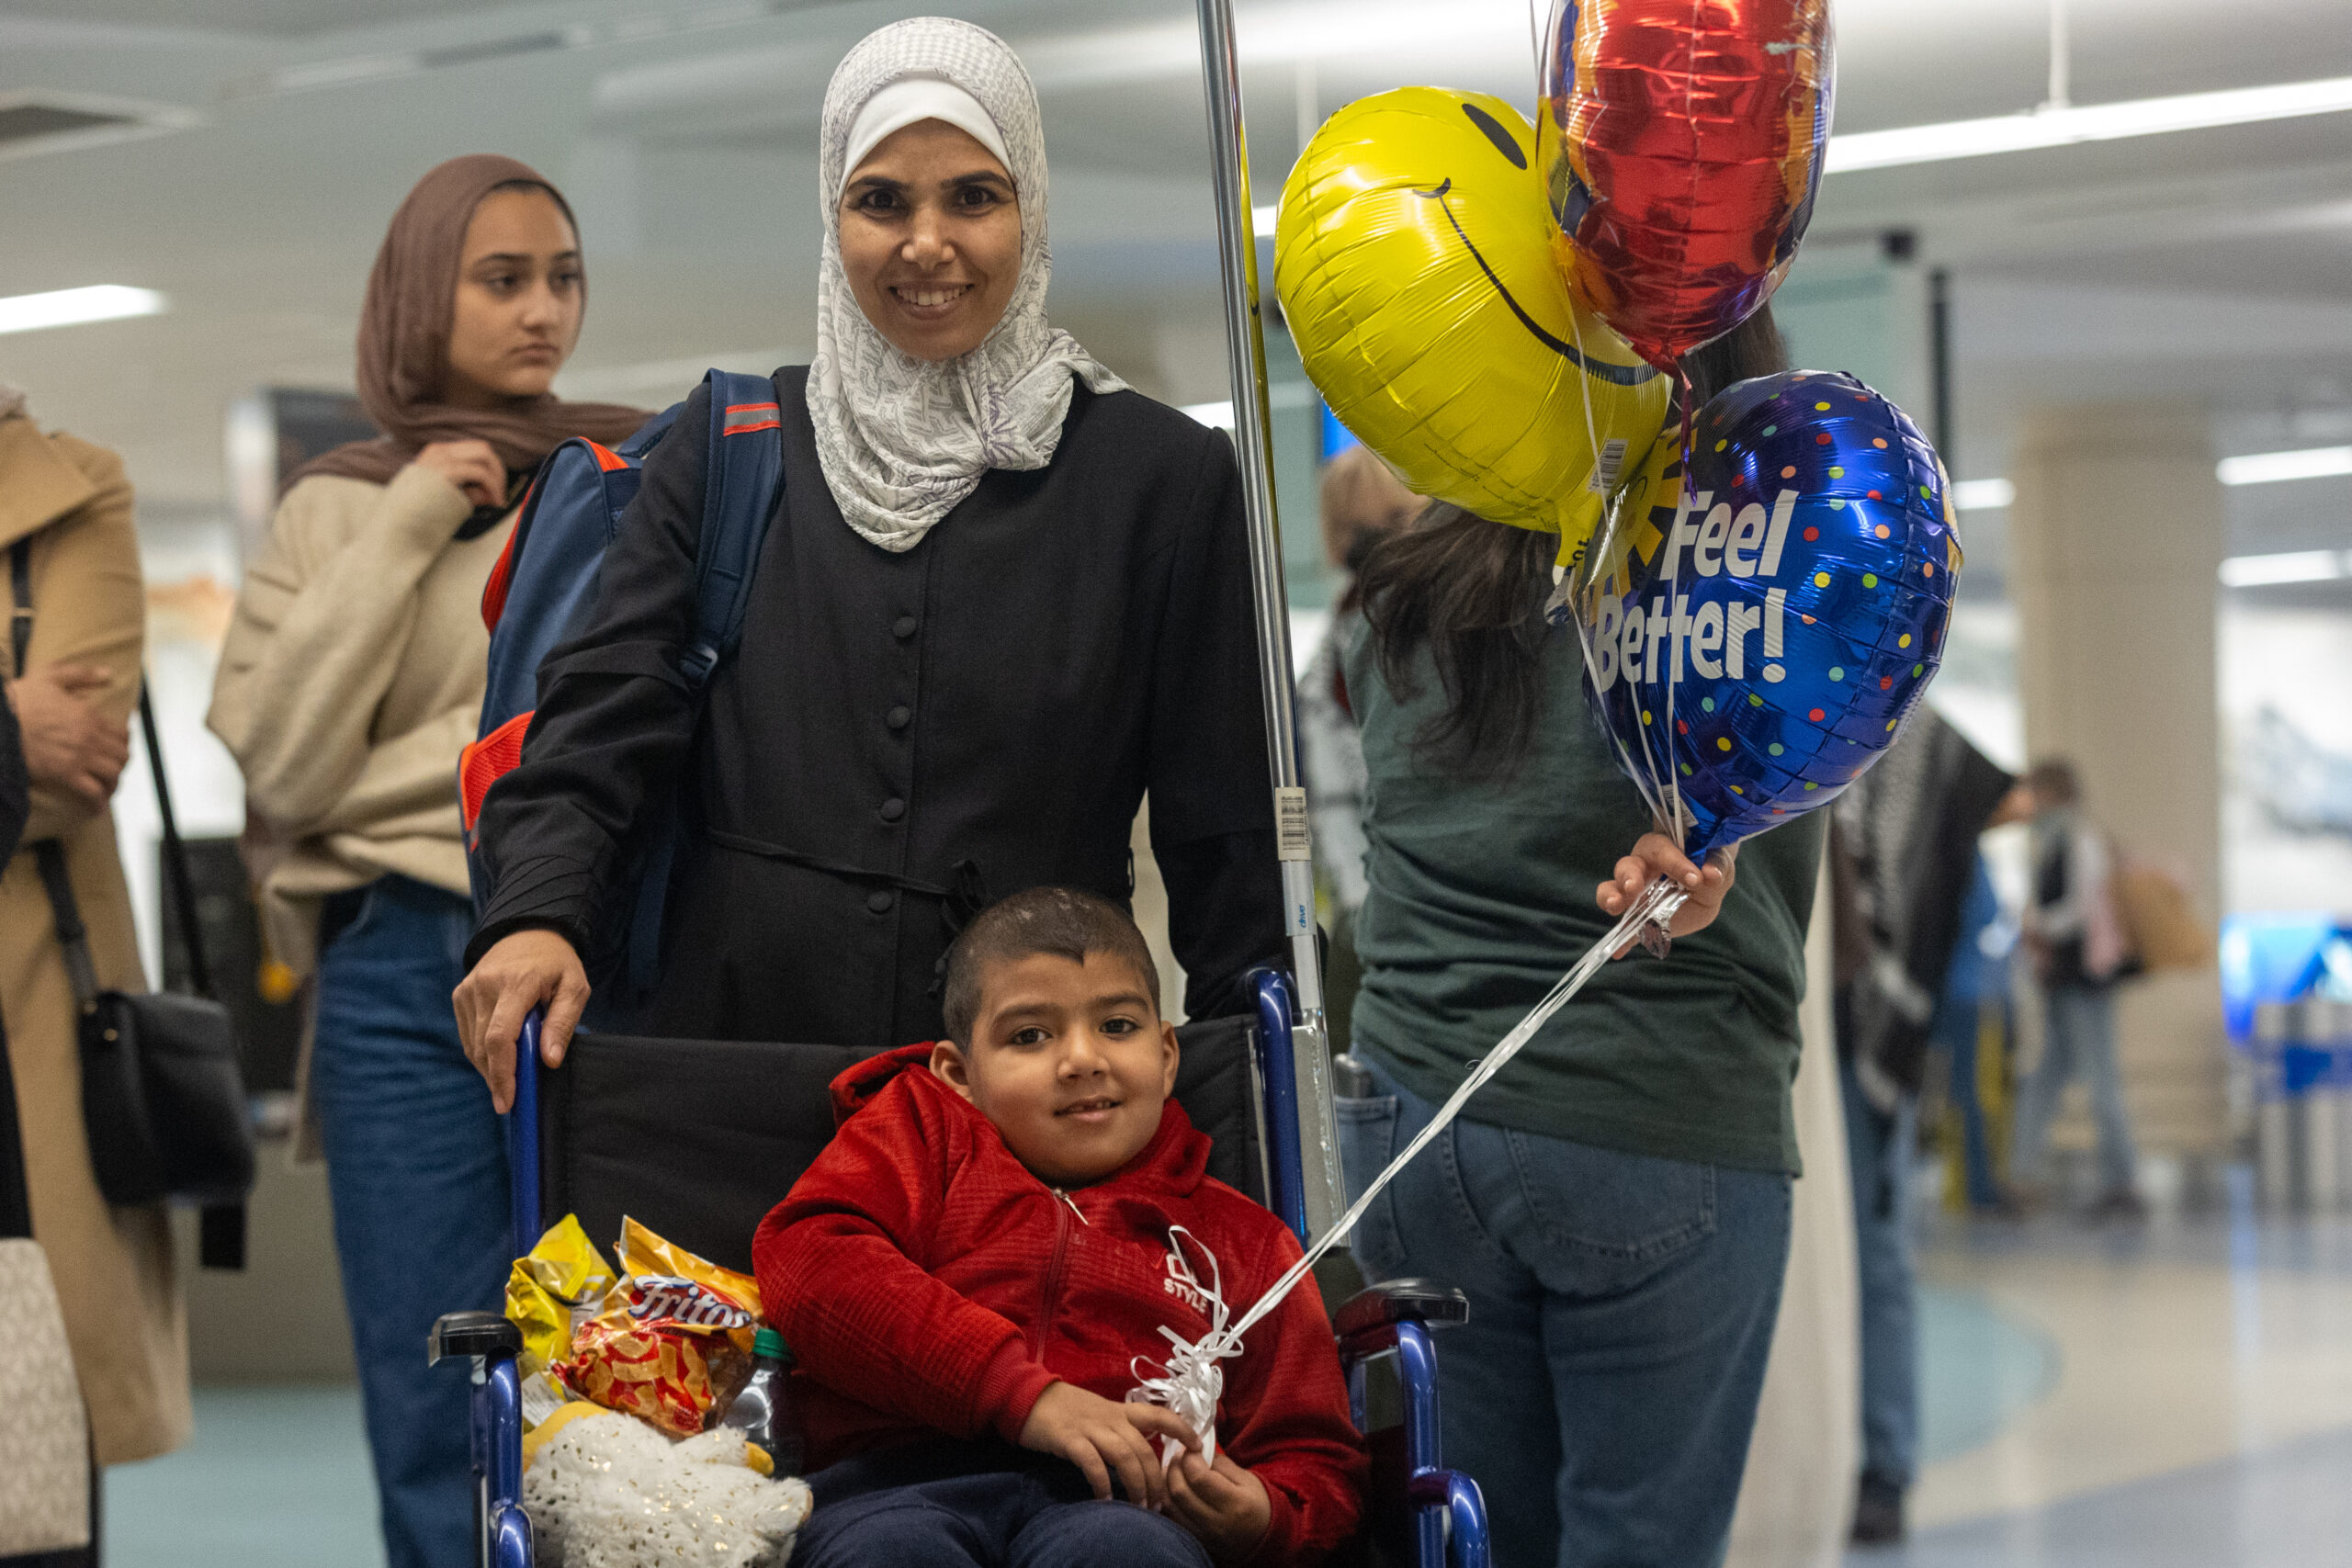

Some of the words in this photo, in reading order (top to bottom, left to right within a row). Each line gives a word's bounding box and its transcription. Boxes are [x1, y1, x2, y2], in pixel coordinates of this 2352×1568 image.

[1659, 489, 1800, 581] Feel
[1593, 588, 1787, 693] Better!
[629, 1275, 752, 1328] Fritos
[1164, 1278, 1208, 1314] STYLE
